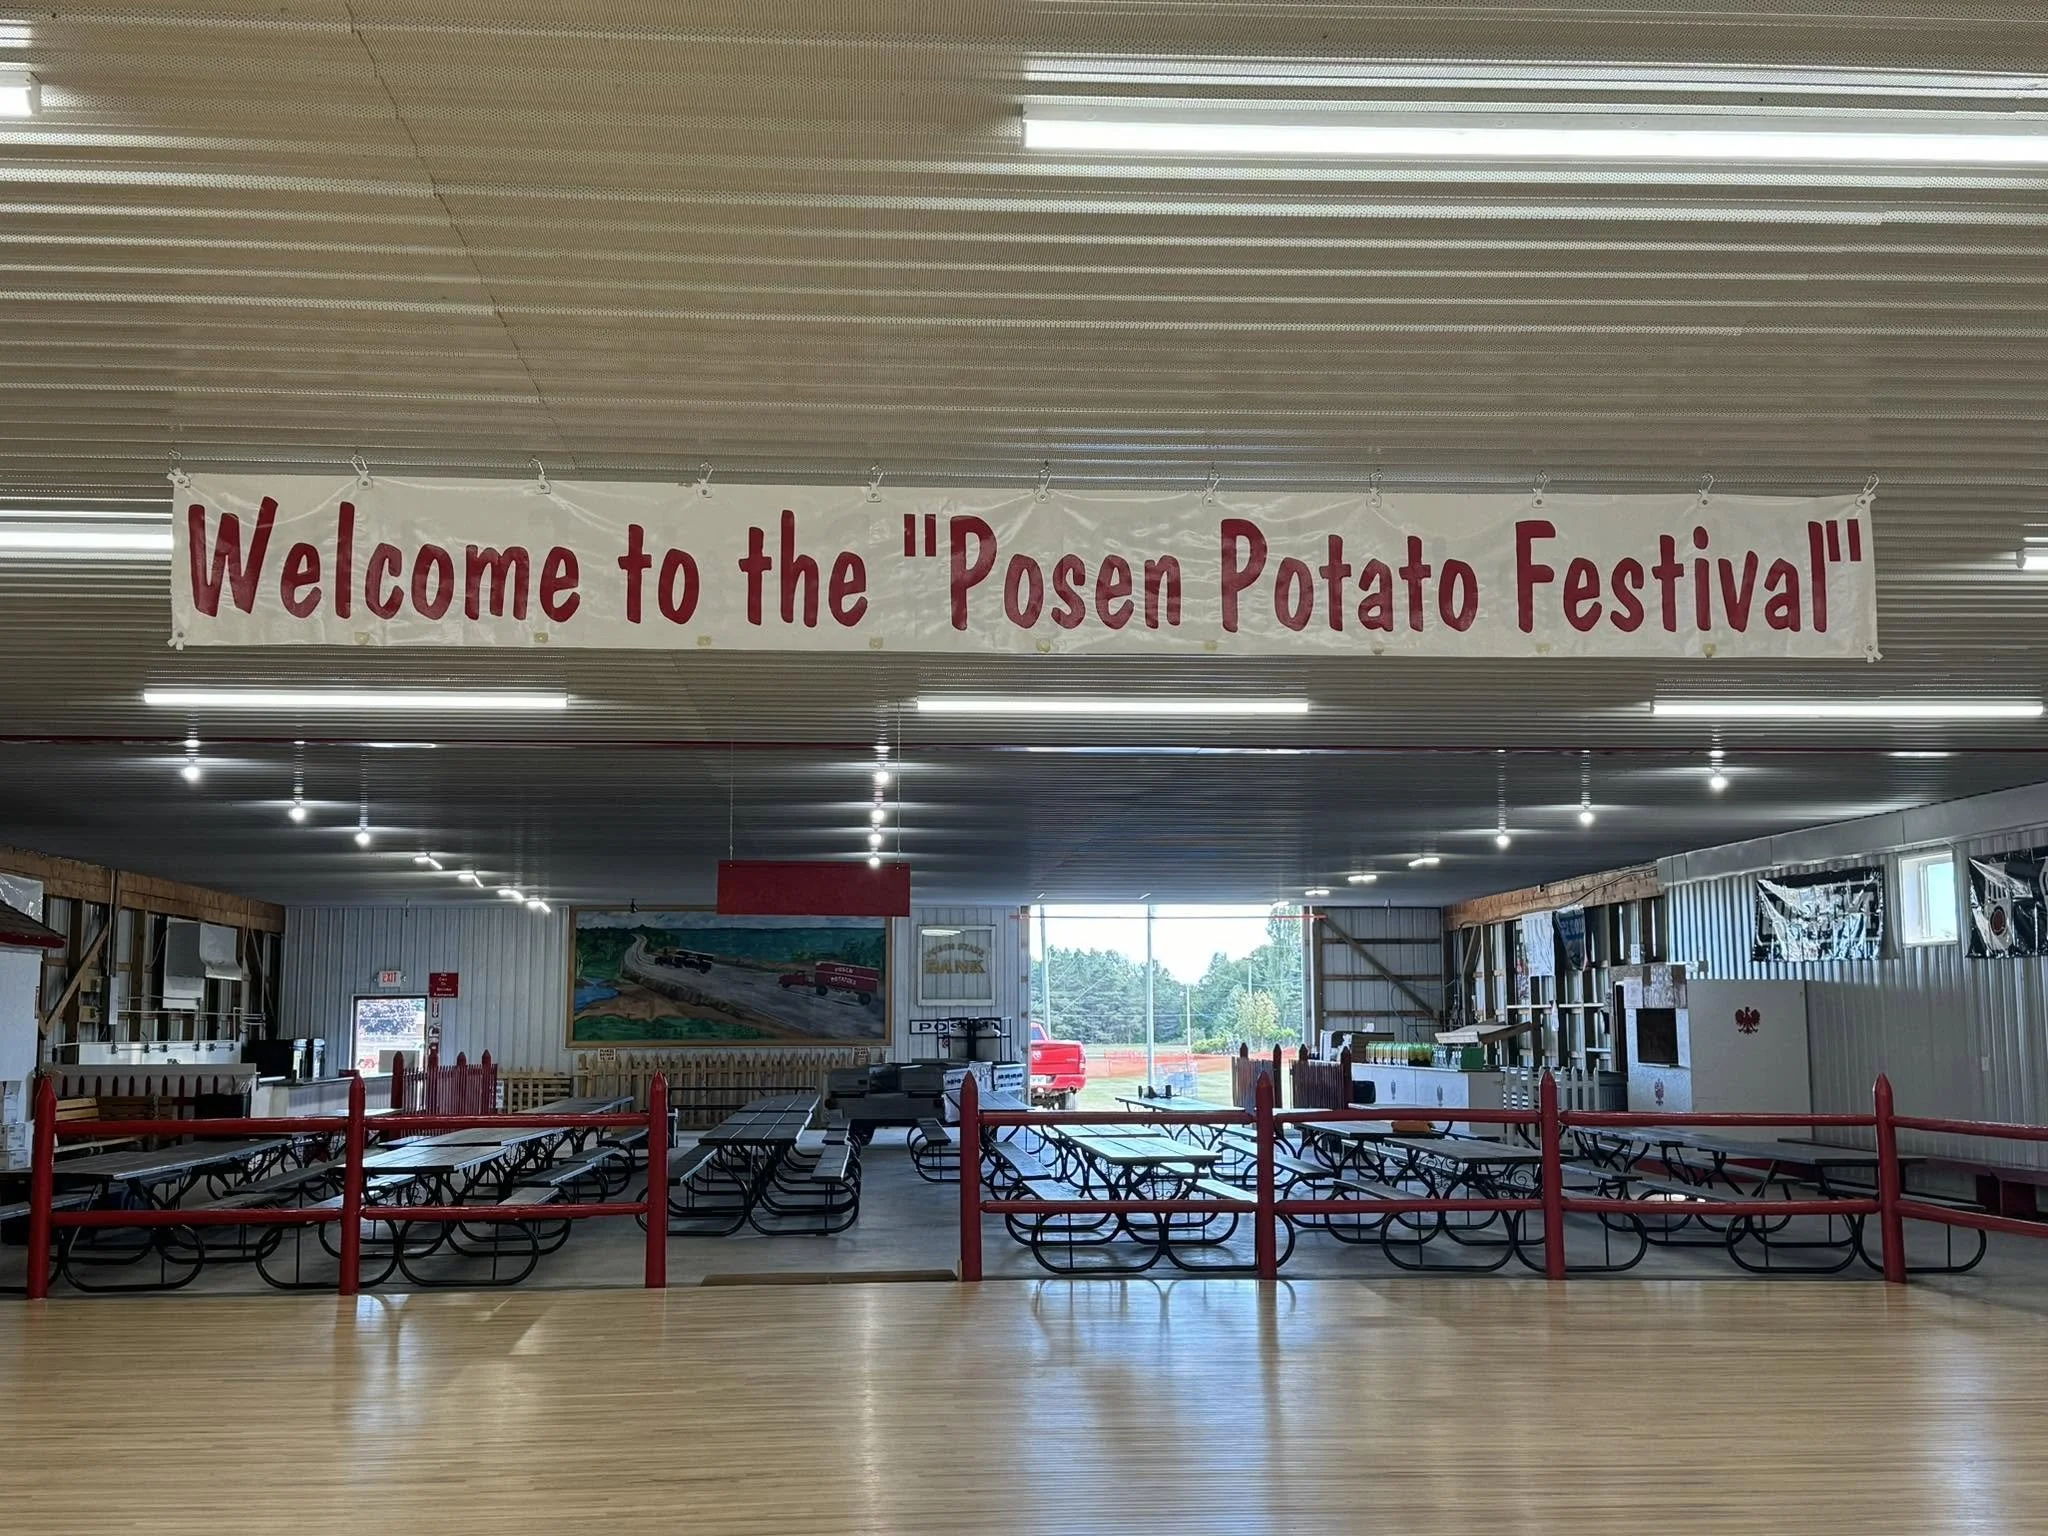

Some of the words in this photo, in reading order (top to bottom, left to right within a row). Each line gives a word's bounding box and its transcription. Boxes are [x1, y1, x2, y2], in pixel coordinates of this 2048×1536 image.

[190, 497, 581, 622] Welcome
[620, 524, 700, 625] to
[738, 509, 869, 627] the
[903, 515, 1181, 631] "Posen
[1221, 518, 1479, 631] Potato
[1516, 520, 1861, 632] Festival"
[925, 959, 987, 974] BANK
[382, 971, 397, 983] EXIT
